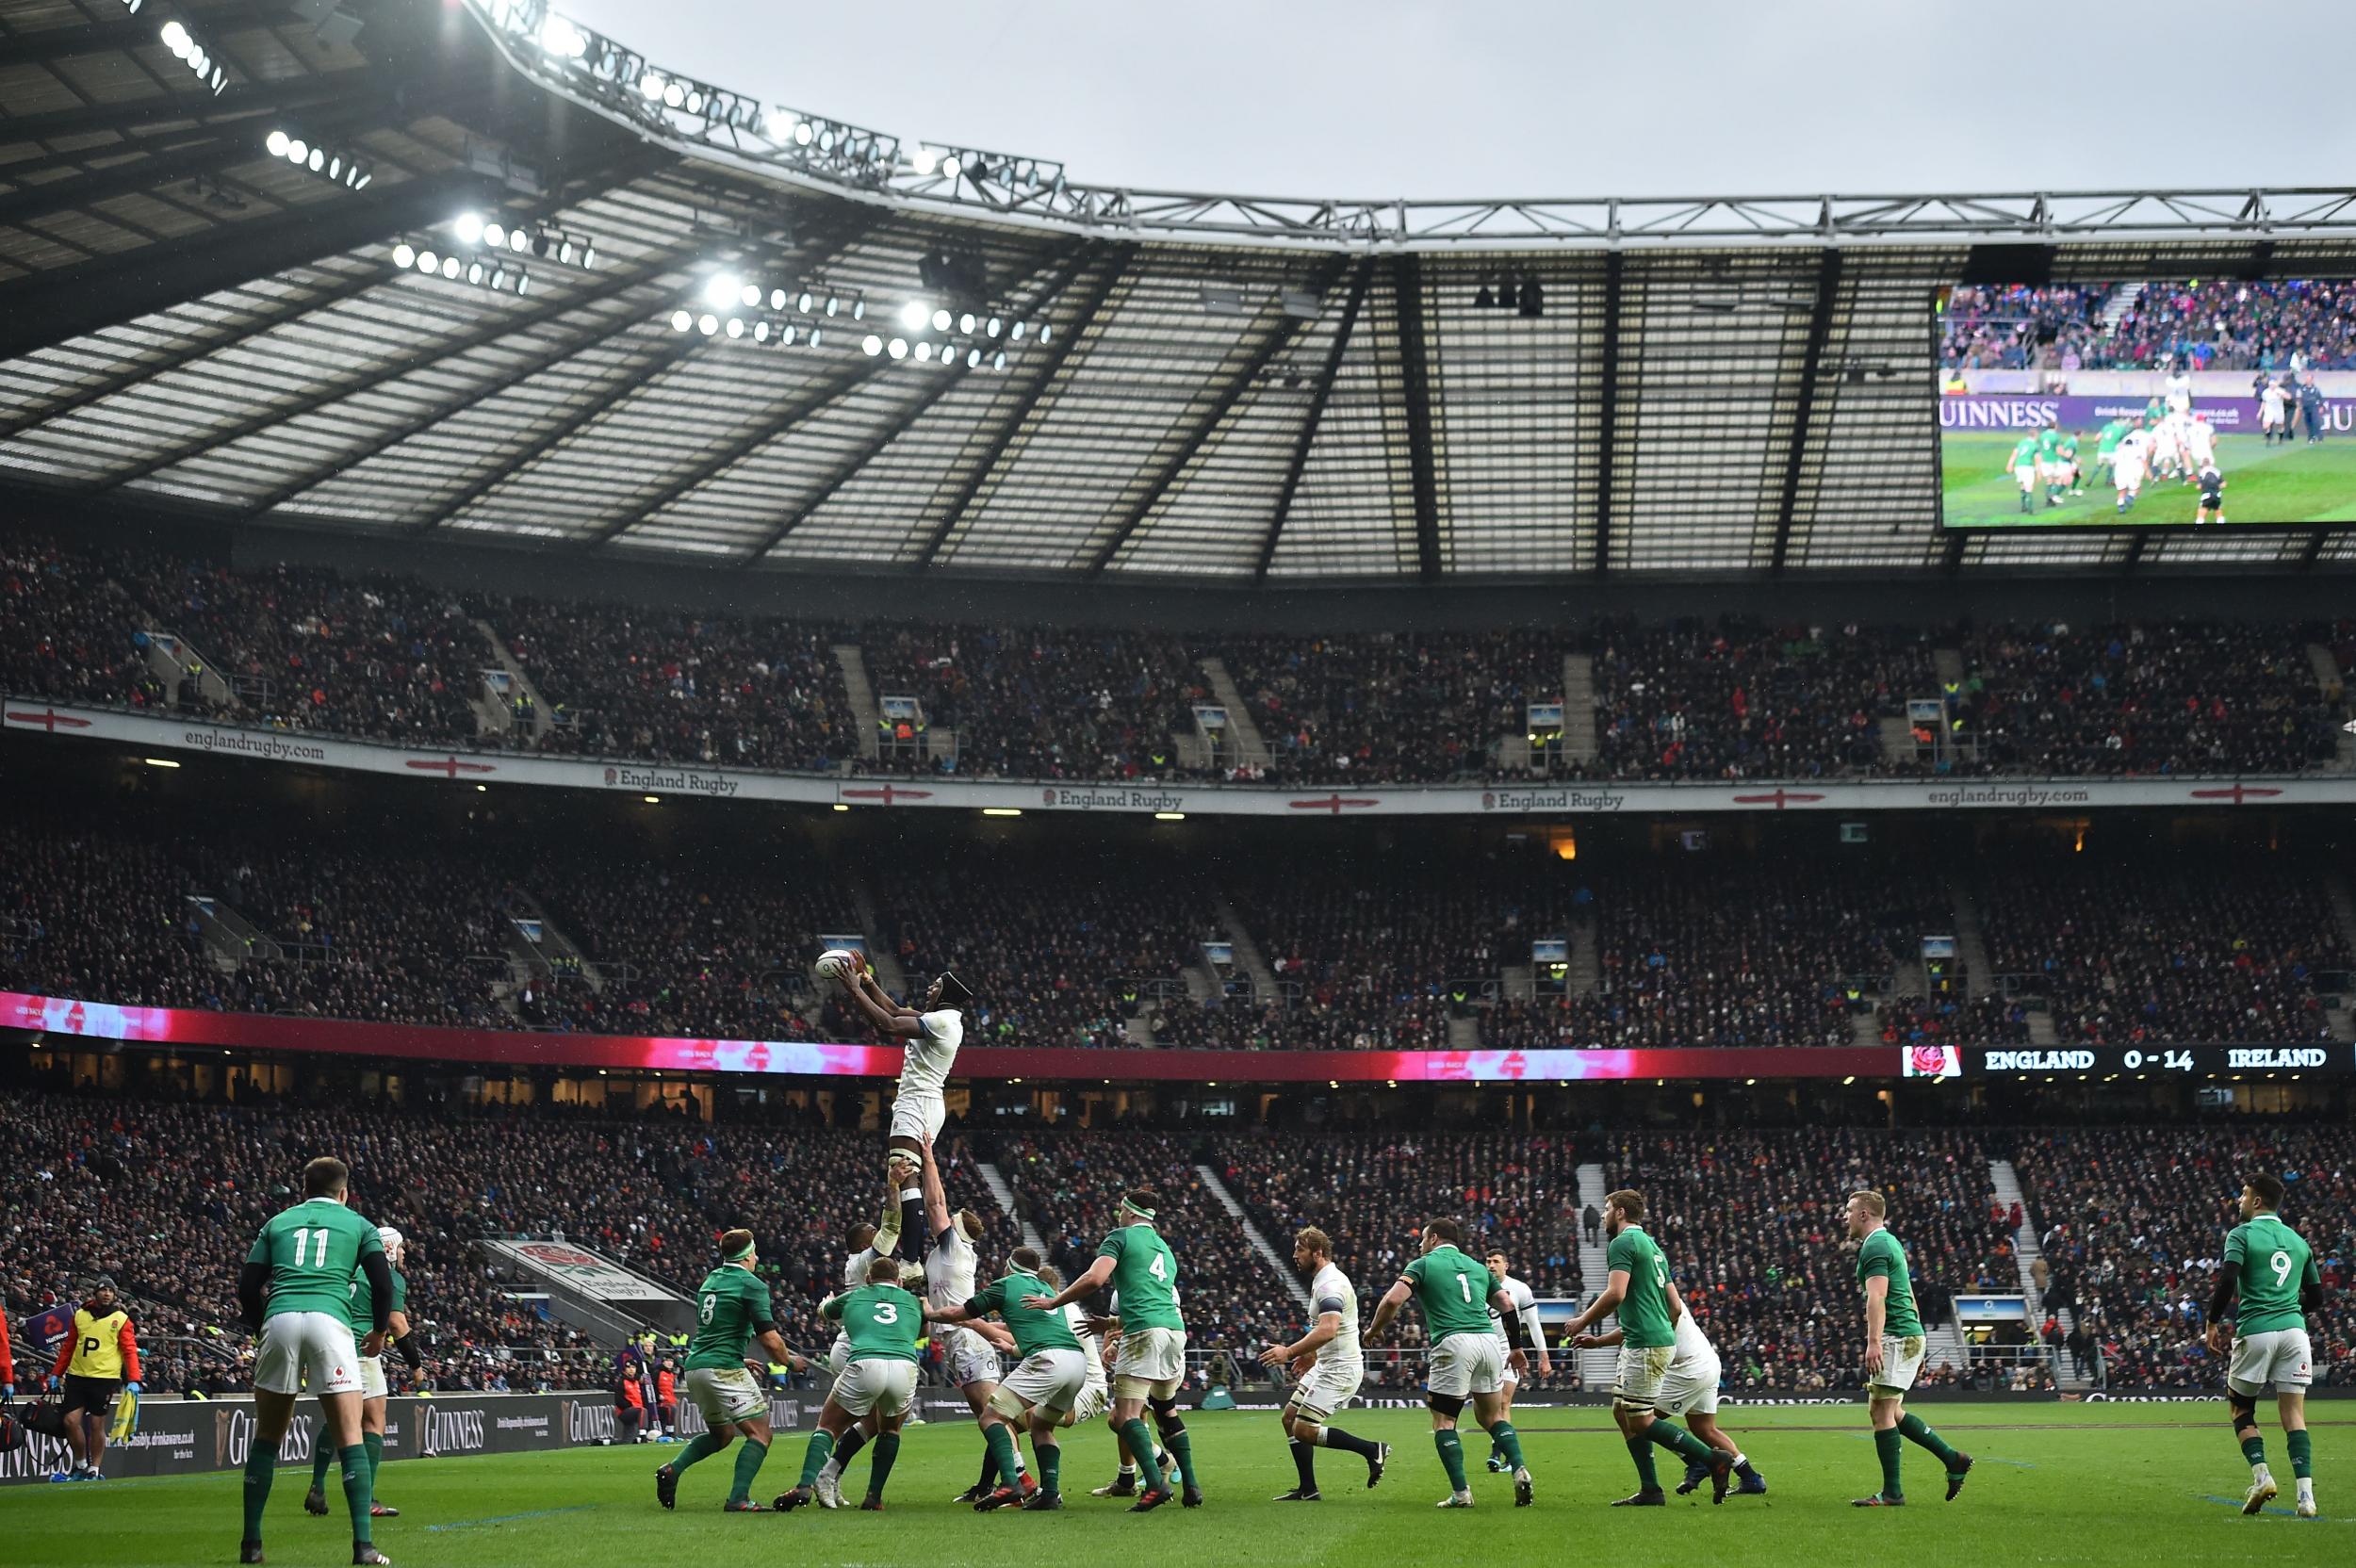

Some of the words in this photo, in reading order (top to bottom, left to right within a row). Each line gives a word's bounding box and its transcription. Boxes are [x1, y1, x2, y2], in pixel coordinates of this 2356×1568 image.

[185, 729, 324, 760] englandrugby.com
[620, 770, 685, 791] England
[689, 775, 739, 796] Rugby
[1928, 786, 2088, 807] englandrugby.com
[1059, 790, 1126, 809] England
[1131, 792, 1183, 811] Rugby
[1498, 792, 1567, 811] England
[1571, 791, 1624, 810] Rugby
[1985, 1050, 2095, 1070] ENGLAND
[2228, 1048, 2327, 1068] IRELAND
[293, 1228, 329, 1267] 11
[1149, 1252, 1168, 1282] 4
[1653, 1255, 1666, 1289] 5
[2270, 1250, 2292, 1287] 9
[1456, 1273, 1472, 1304] 1
[700, 1294, 716, 1326] 8
[873, 1302, 898, 1324] 3
[82, 1337, 100, 1358] P
[229, 1409, 311, 1465] GUESS
[424, 1404, 484, 1452] GUINNESS
